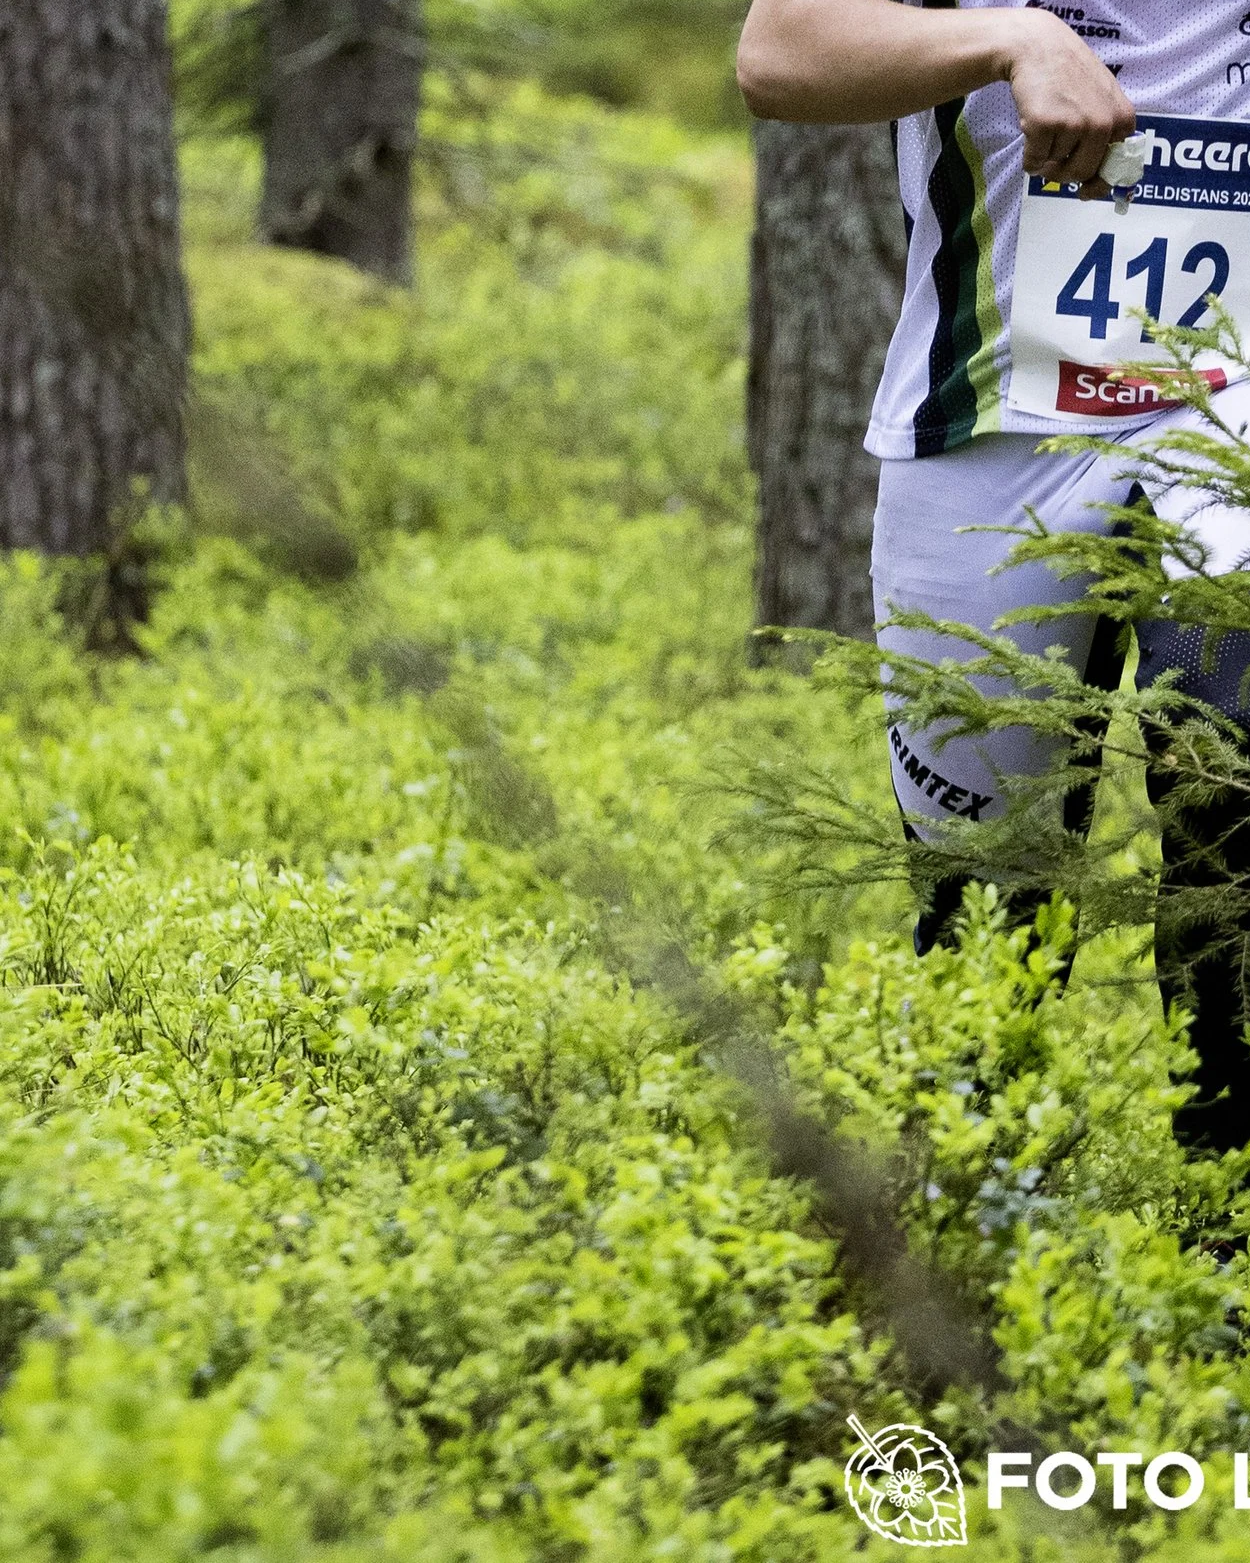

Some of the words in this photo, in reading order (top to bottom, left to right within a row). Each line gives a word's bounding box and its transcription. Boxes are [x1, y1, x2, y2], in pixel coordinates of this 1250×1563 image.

[1070, 24, 1120, 39] rsson
[1111, 184, 1229, 205] DELDISTANS
[1055, 232, 1230, 345] 412
[1075, 374, 1190, 411] Scan
[890, 726, 993, 822] RIMTEX
